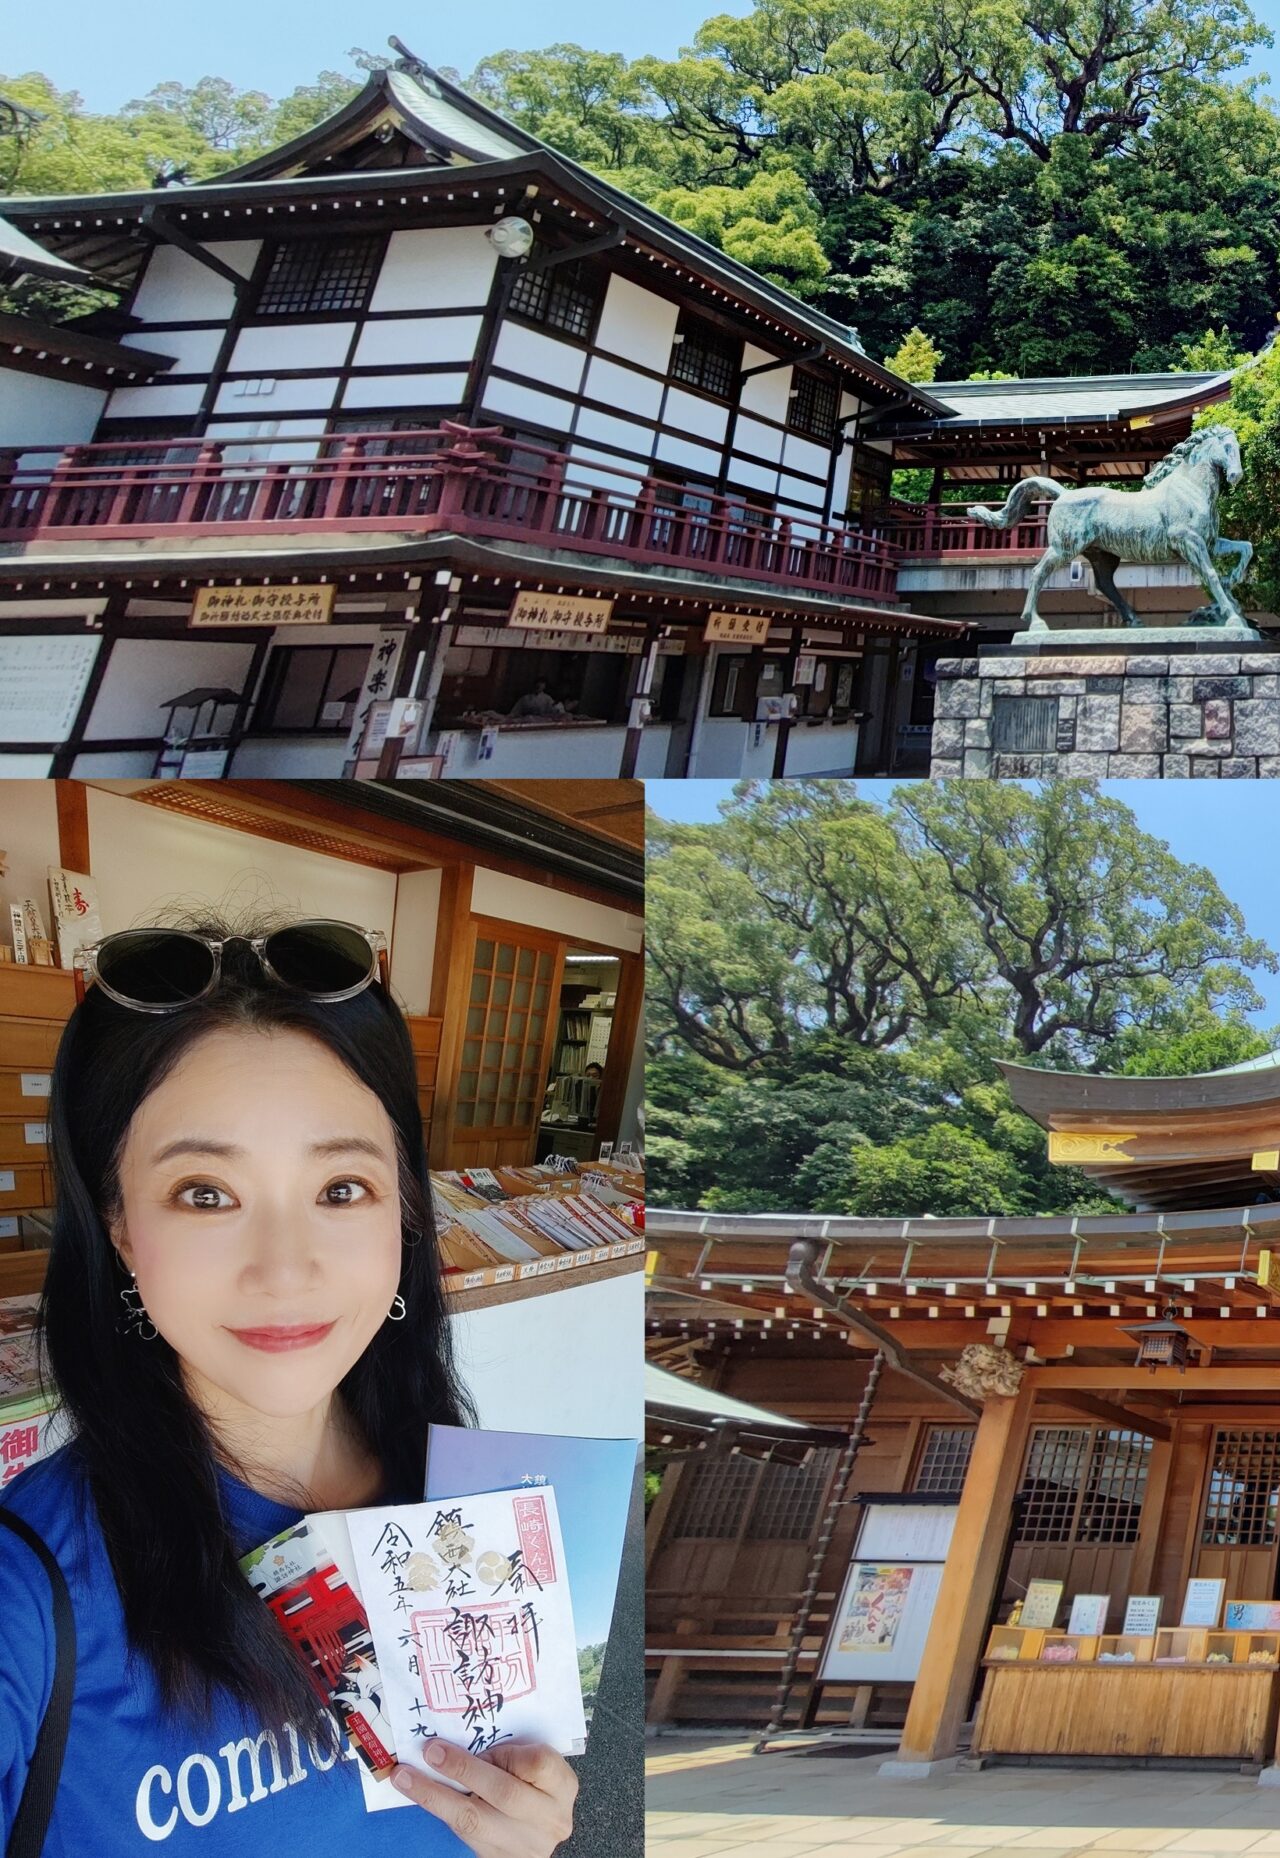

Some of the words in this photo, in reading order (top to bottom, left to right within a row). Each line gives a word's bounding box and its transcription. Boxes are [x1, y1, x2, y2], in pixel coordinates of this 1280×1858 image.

[426, 1507, 476, 1606] 鎮西大社
[519, 1501, 550, 1581] 長崎くんち
[1233, 1604, 1245, 1621] 男
[443, 1606, 513, 1755] 諏訪神社
